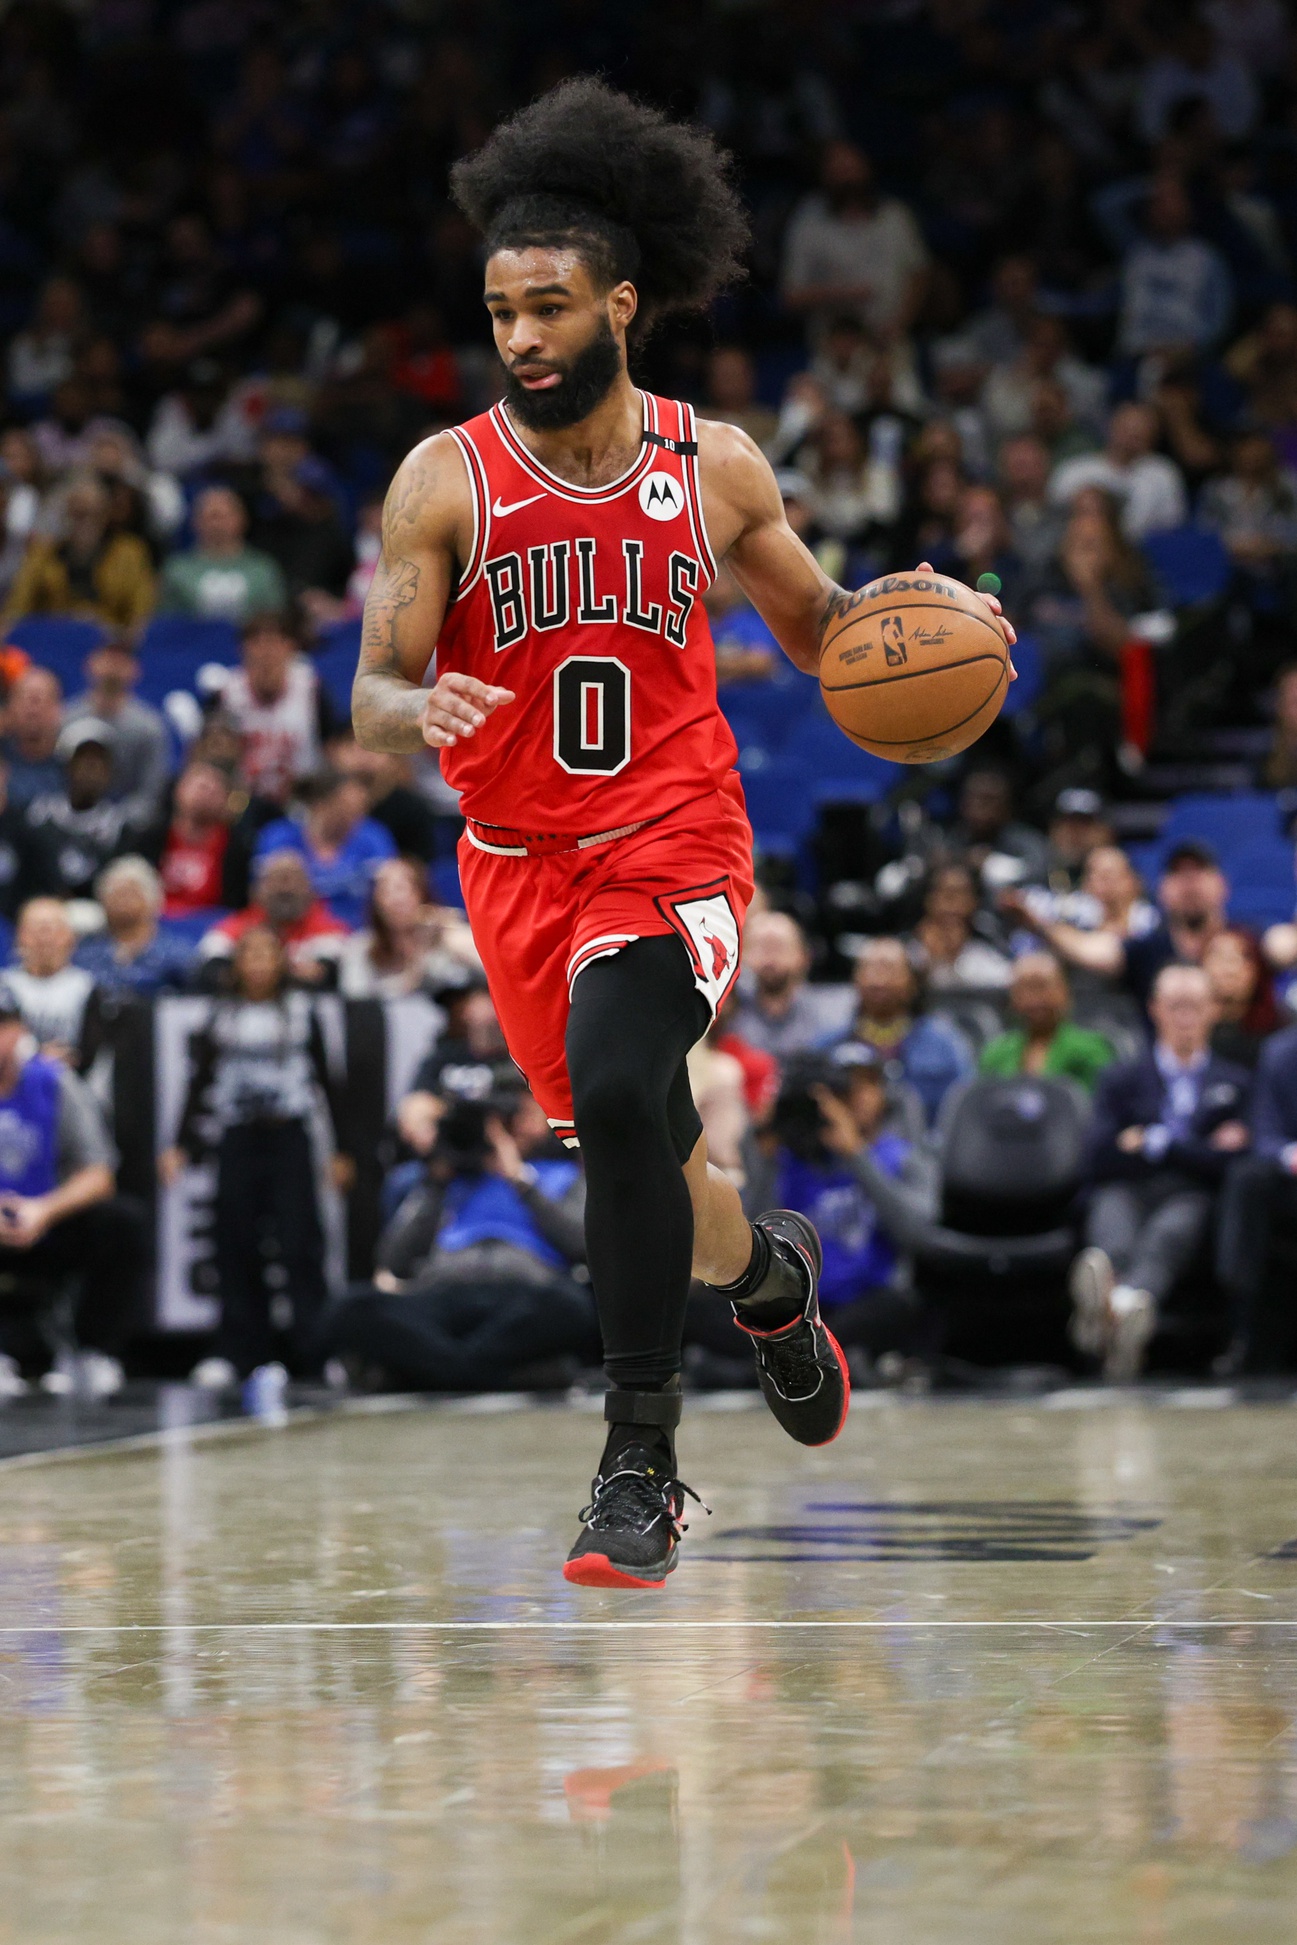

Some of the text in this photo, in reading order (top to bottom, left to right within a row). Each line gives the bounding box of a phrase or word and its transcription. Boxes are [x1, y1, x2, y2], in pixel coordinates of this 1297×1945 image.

[664, 438, 675, 452] 10
[483, 537, 699, 653] BULLS
[553, 655, 631, 776] 0
